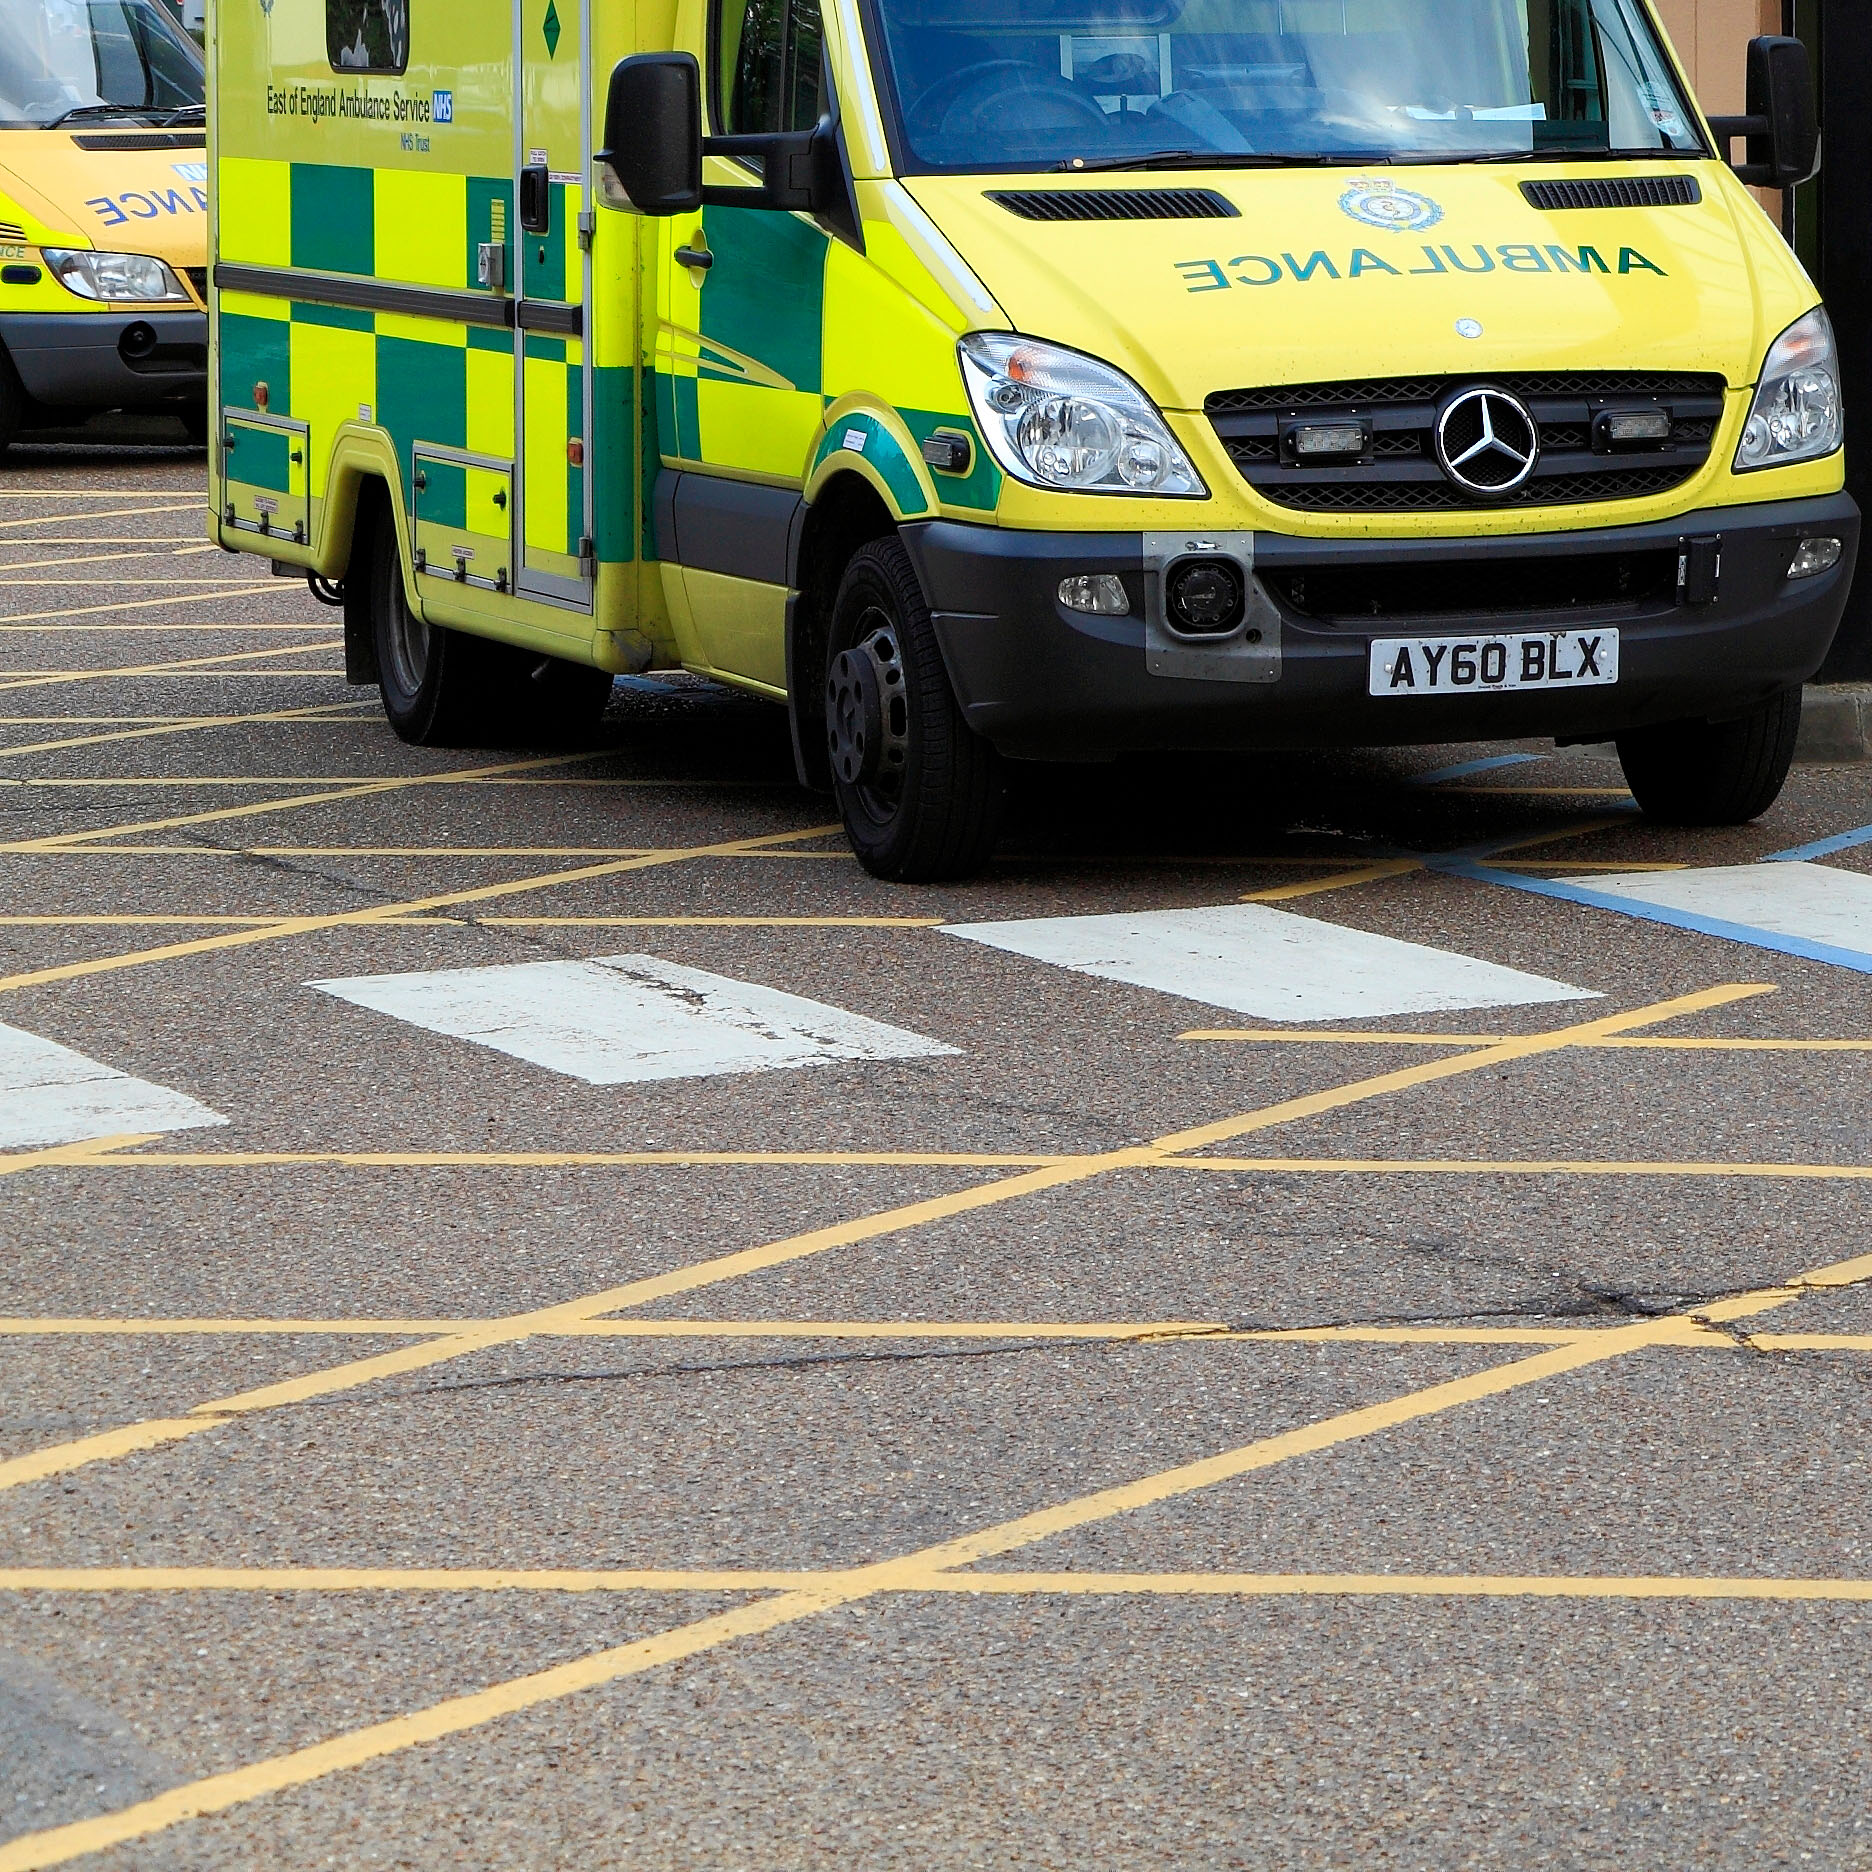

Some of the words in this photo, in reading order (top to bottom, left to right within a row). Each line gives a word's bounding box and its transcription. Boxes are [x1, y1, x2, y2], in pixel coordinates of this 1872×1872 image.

[267, 85, 287, 115] East
[289, 86, 298, 115] of
[300, 87, 336, 124] England
[339, 88, 390, 121] Ambulance
[393, 90, 430, 123] Service
[433, 92, 452, 122] NHS
[400, 133, 413, 151] NHS
[415, 134, 430, 152] Trust
[1389, 642, 1506, 688] AY60
[1519, 636, 1602, 682] BLX
